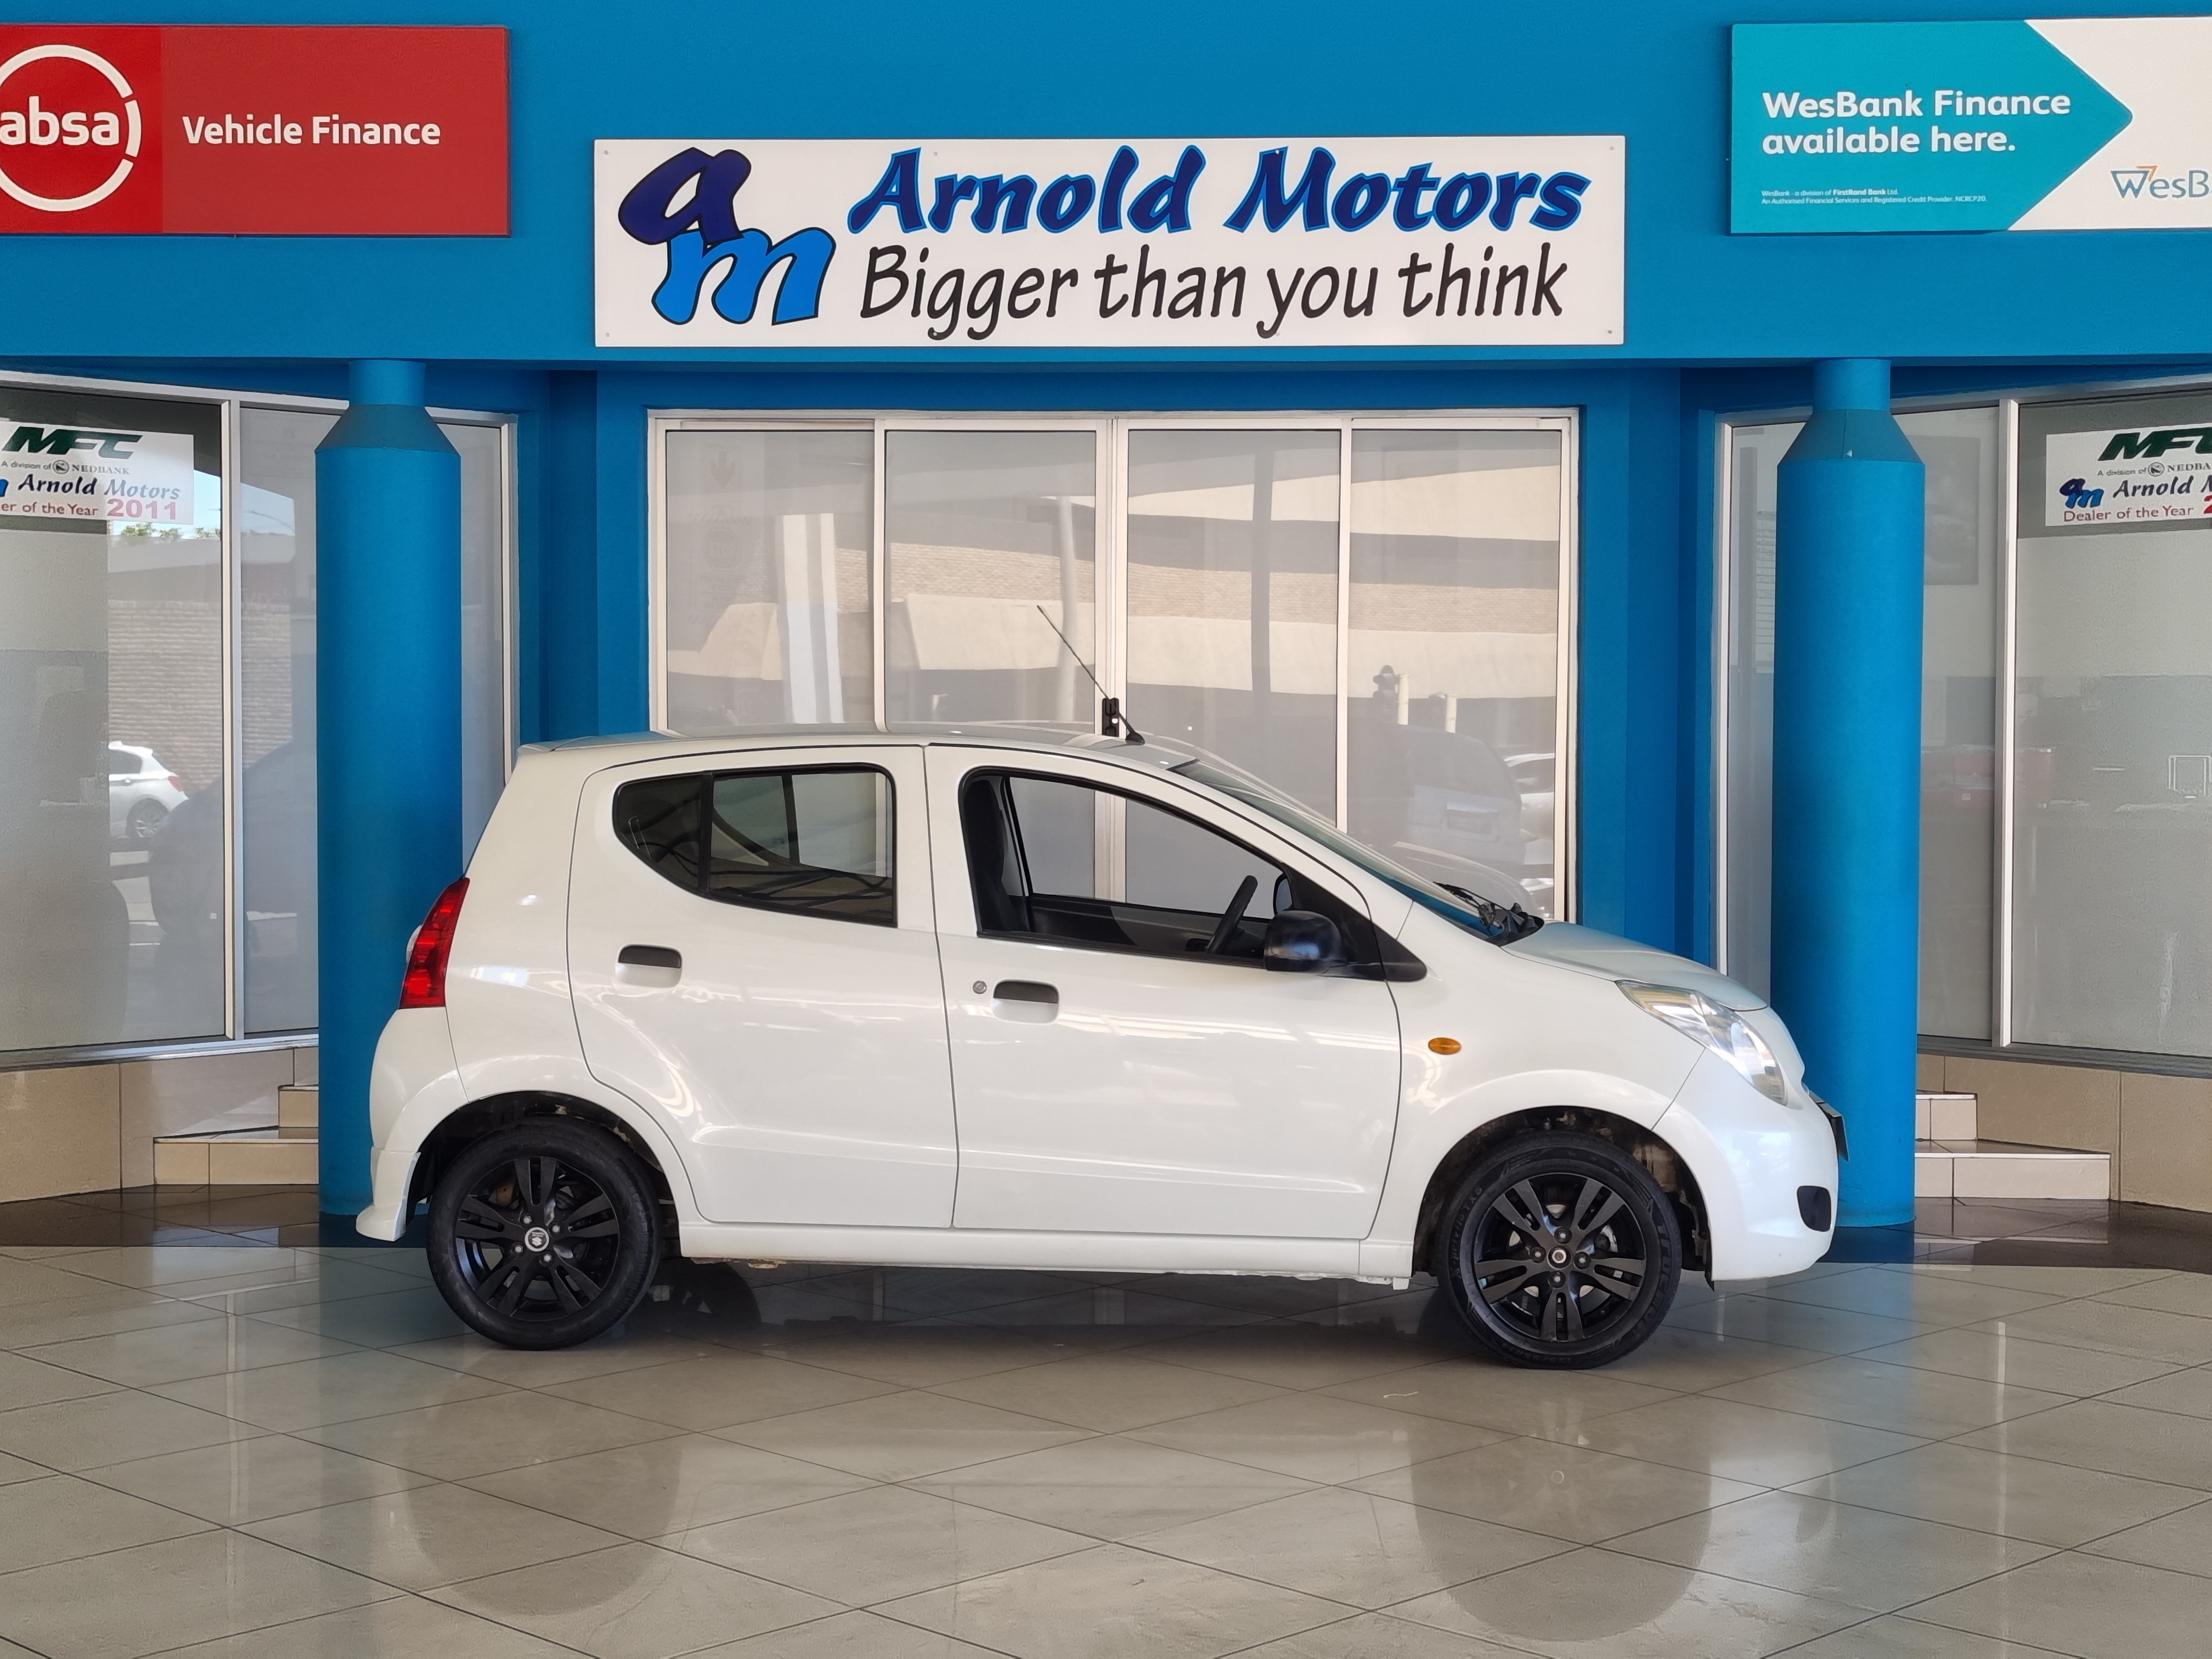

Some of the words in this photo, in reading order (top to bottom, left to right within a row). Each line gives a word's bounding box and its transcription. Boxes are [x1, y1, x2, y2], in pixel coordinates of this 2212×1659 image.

[1763, 90, 1923, 118] WesBank
[1936, 89, 2070, 116] Finance
[0, 96, 119, 145] absa
[183, 114, 302, 144] Vehicle
[313, 114, 441, 144] Finance
[1763, 126, 1920, 155] available
[1932, 126, 2015, 152] here.
[847, 145, 1206, 234] Arnold
[1223, 146, 1592, 233] Motors
[860, 245, 1079, 341] Bigger
[1094, 244, 1246, 319] than
[1256, 267, 1378, 339] you
[1398, 242, 1567, 317] think
[2, 426, 143, 459] MFC
[72, 464, 129, 475] NEDBANK
[18, 473, 98, 495] Arnold
[104, 479, 181, 501] Motors
[2113, 475, 2194, 499] Arnold
[22, 501, 37, 513] of
[42, 503, 65, 515] the
[67, 503, 99, 516] Year
[107, 498, 176, 520] 2011
[2064, 510, 2111, 522] Dealer
[2117, 507, 2132, 519] of
[2136, 507, 2159, 517] the
[2162, 505, 2194, 517] Year
